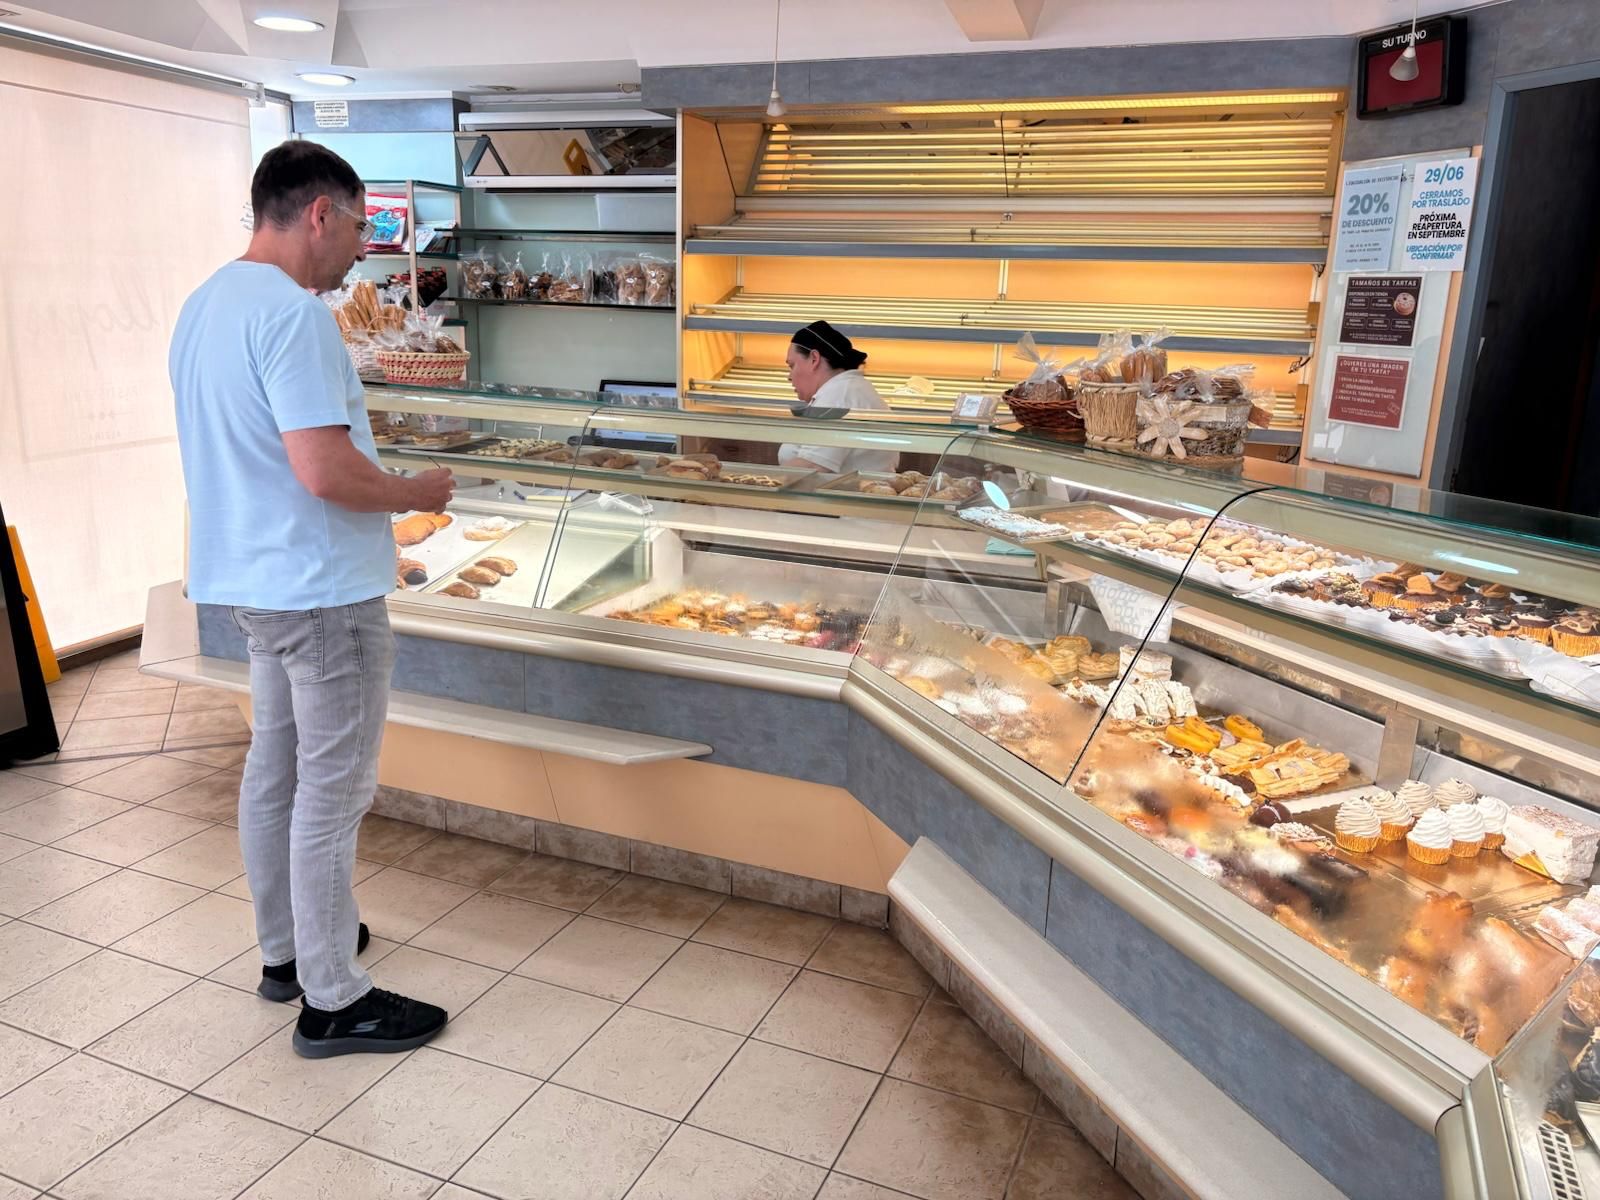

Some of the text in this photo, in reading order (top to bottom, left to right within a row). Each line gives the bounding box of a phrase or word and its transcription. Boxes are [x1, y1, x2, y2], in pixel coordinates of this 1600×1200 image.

[1382, 30, 1426, 48] SU TURNO
[1424, 164, 1464, 184] 29/06
[1420, 189, 1463, 199] CERRAMOS
[1347, 192, 1390, 215] 20%
[1412, 197, 1470, 208] POR TRASLADO
[1419, 211, 1456, 222] PRÓXIMA
[1342, 217, 1393, 228] DE DESCUENTO
[1412, 221, 1462, 230] REAPERTURA
[1408, 229, 1466, 239] EN SEPTIEMBRE
[1406, 242, 1463, 252] UBICACIÓN POR
[1411, 252, 1454, 260] CONFIRMAR
[1351, 279, 1380, 287] TAMAÑOS
